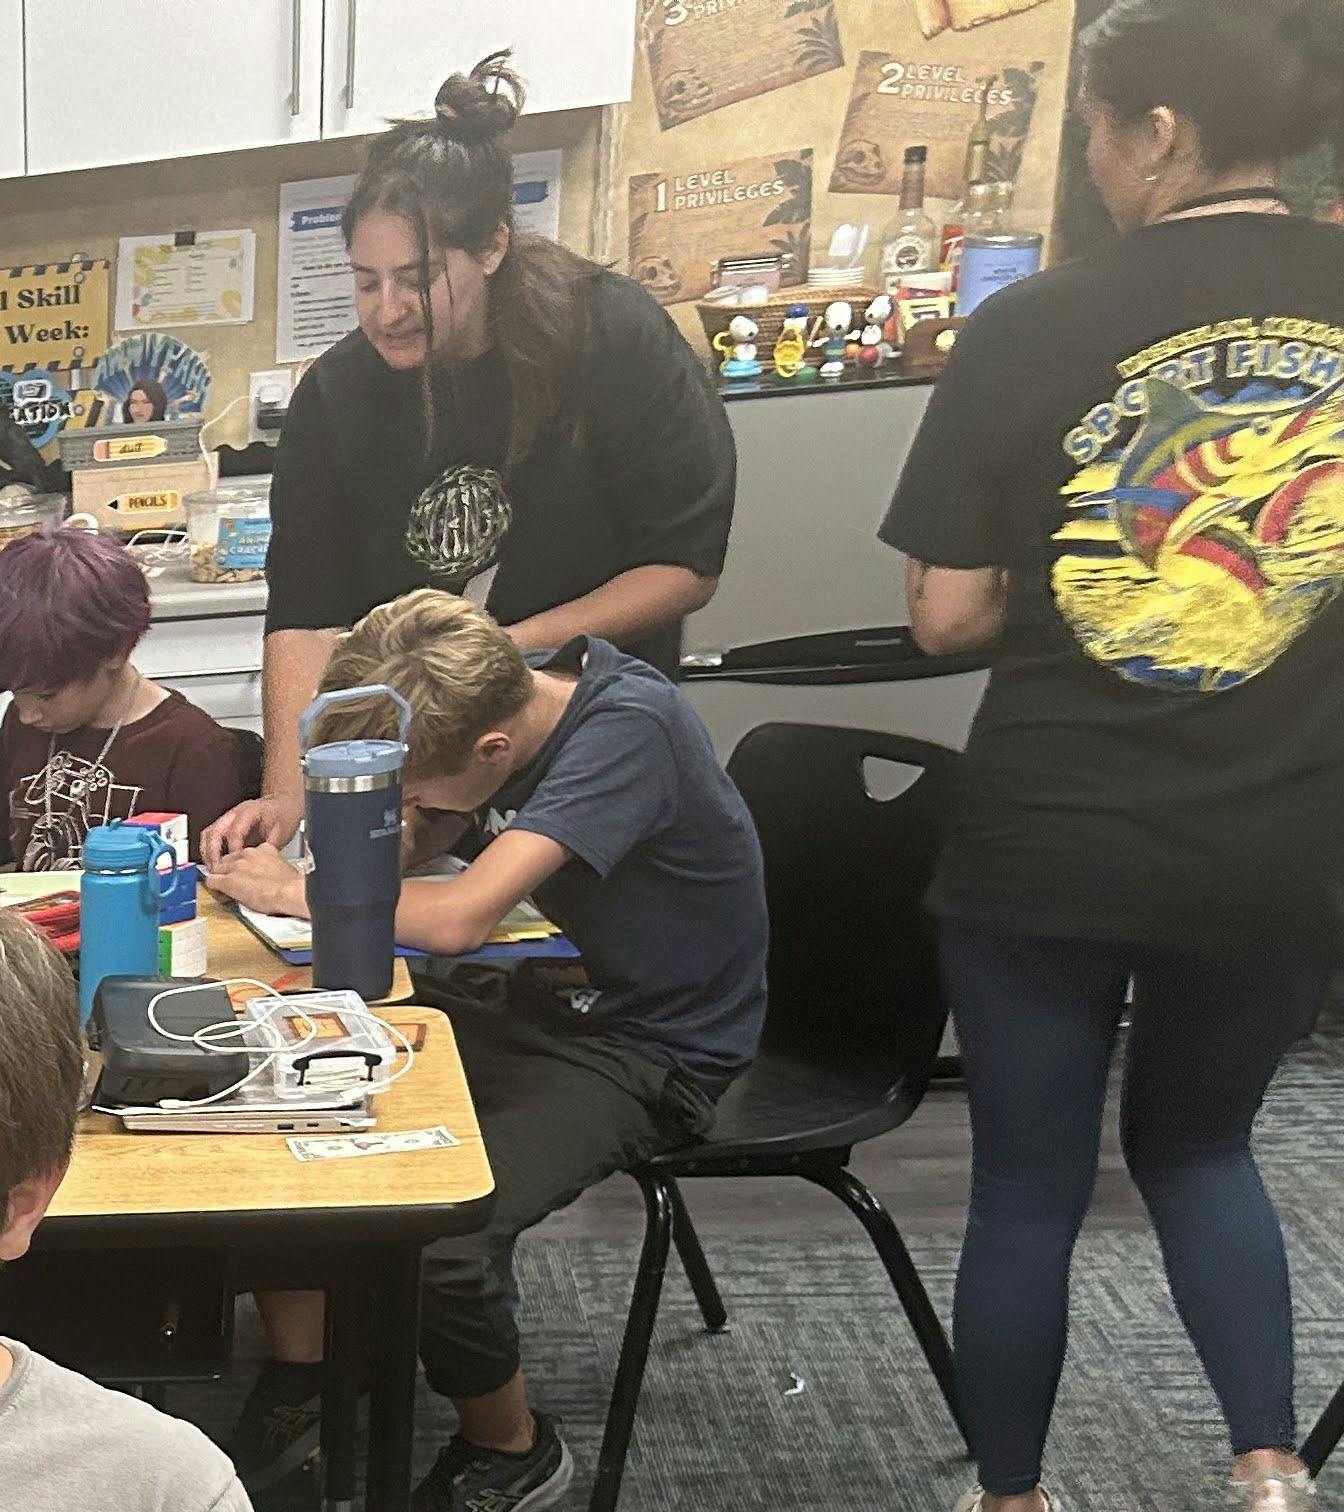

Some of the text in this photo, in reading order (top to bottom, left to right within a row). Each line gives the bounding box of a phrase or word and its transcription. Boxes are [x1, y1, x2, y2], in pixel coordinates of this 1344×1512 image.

[876, 62, 906, 94] 2
[905, 63, 964, 83] LEVEL
[675, 169, 736, 193] LEVEL
[655, 179, 785, 213] 1 PRIVILEGES
[17, 284, 80, 310] Skill
[5, 320, 89, 346] Week:
[128, 492, 169, 510] PENCILS
